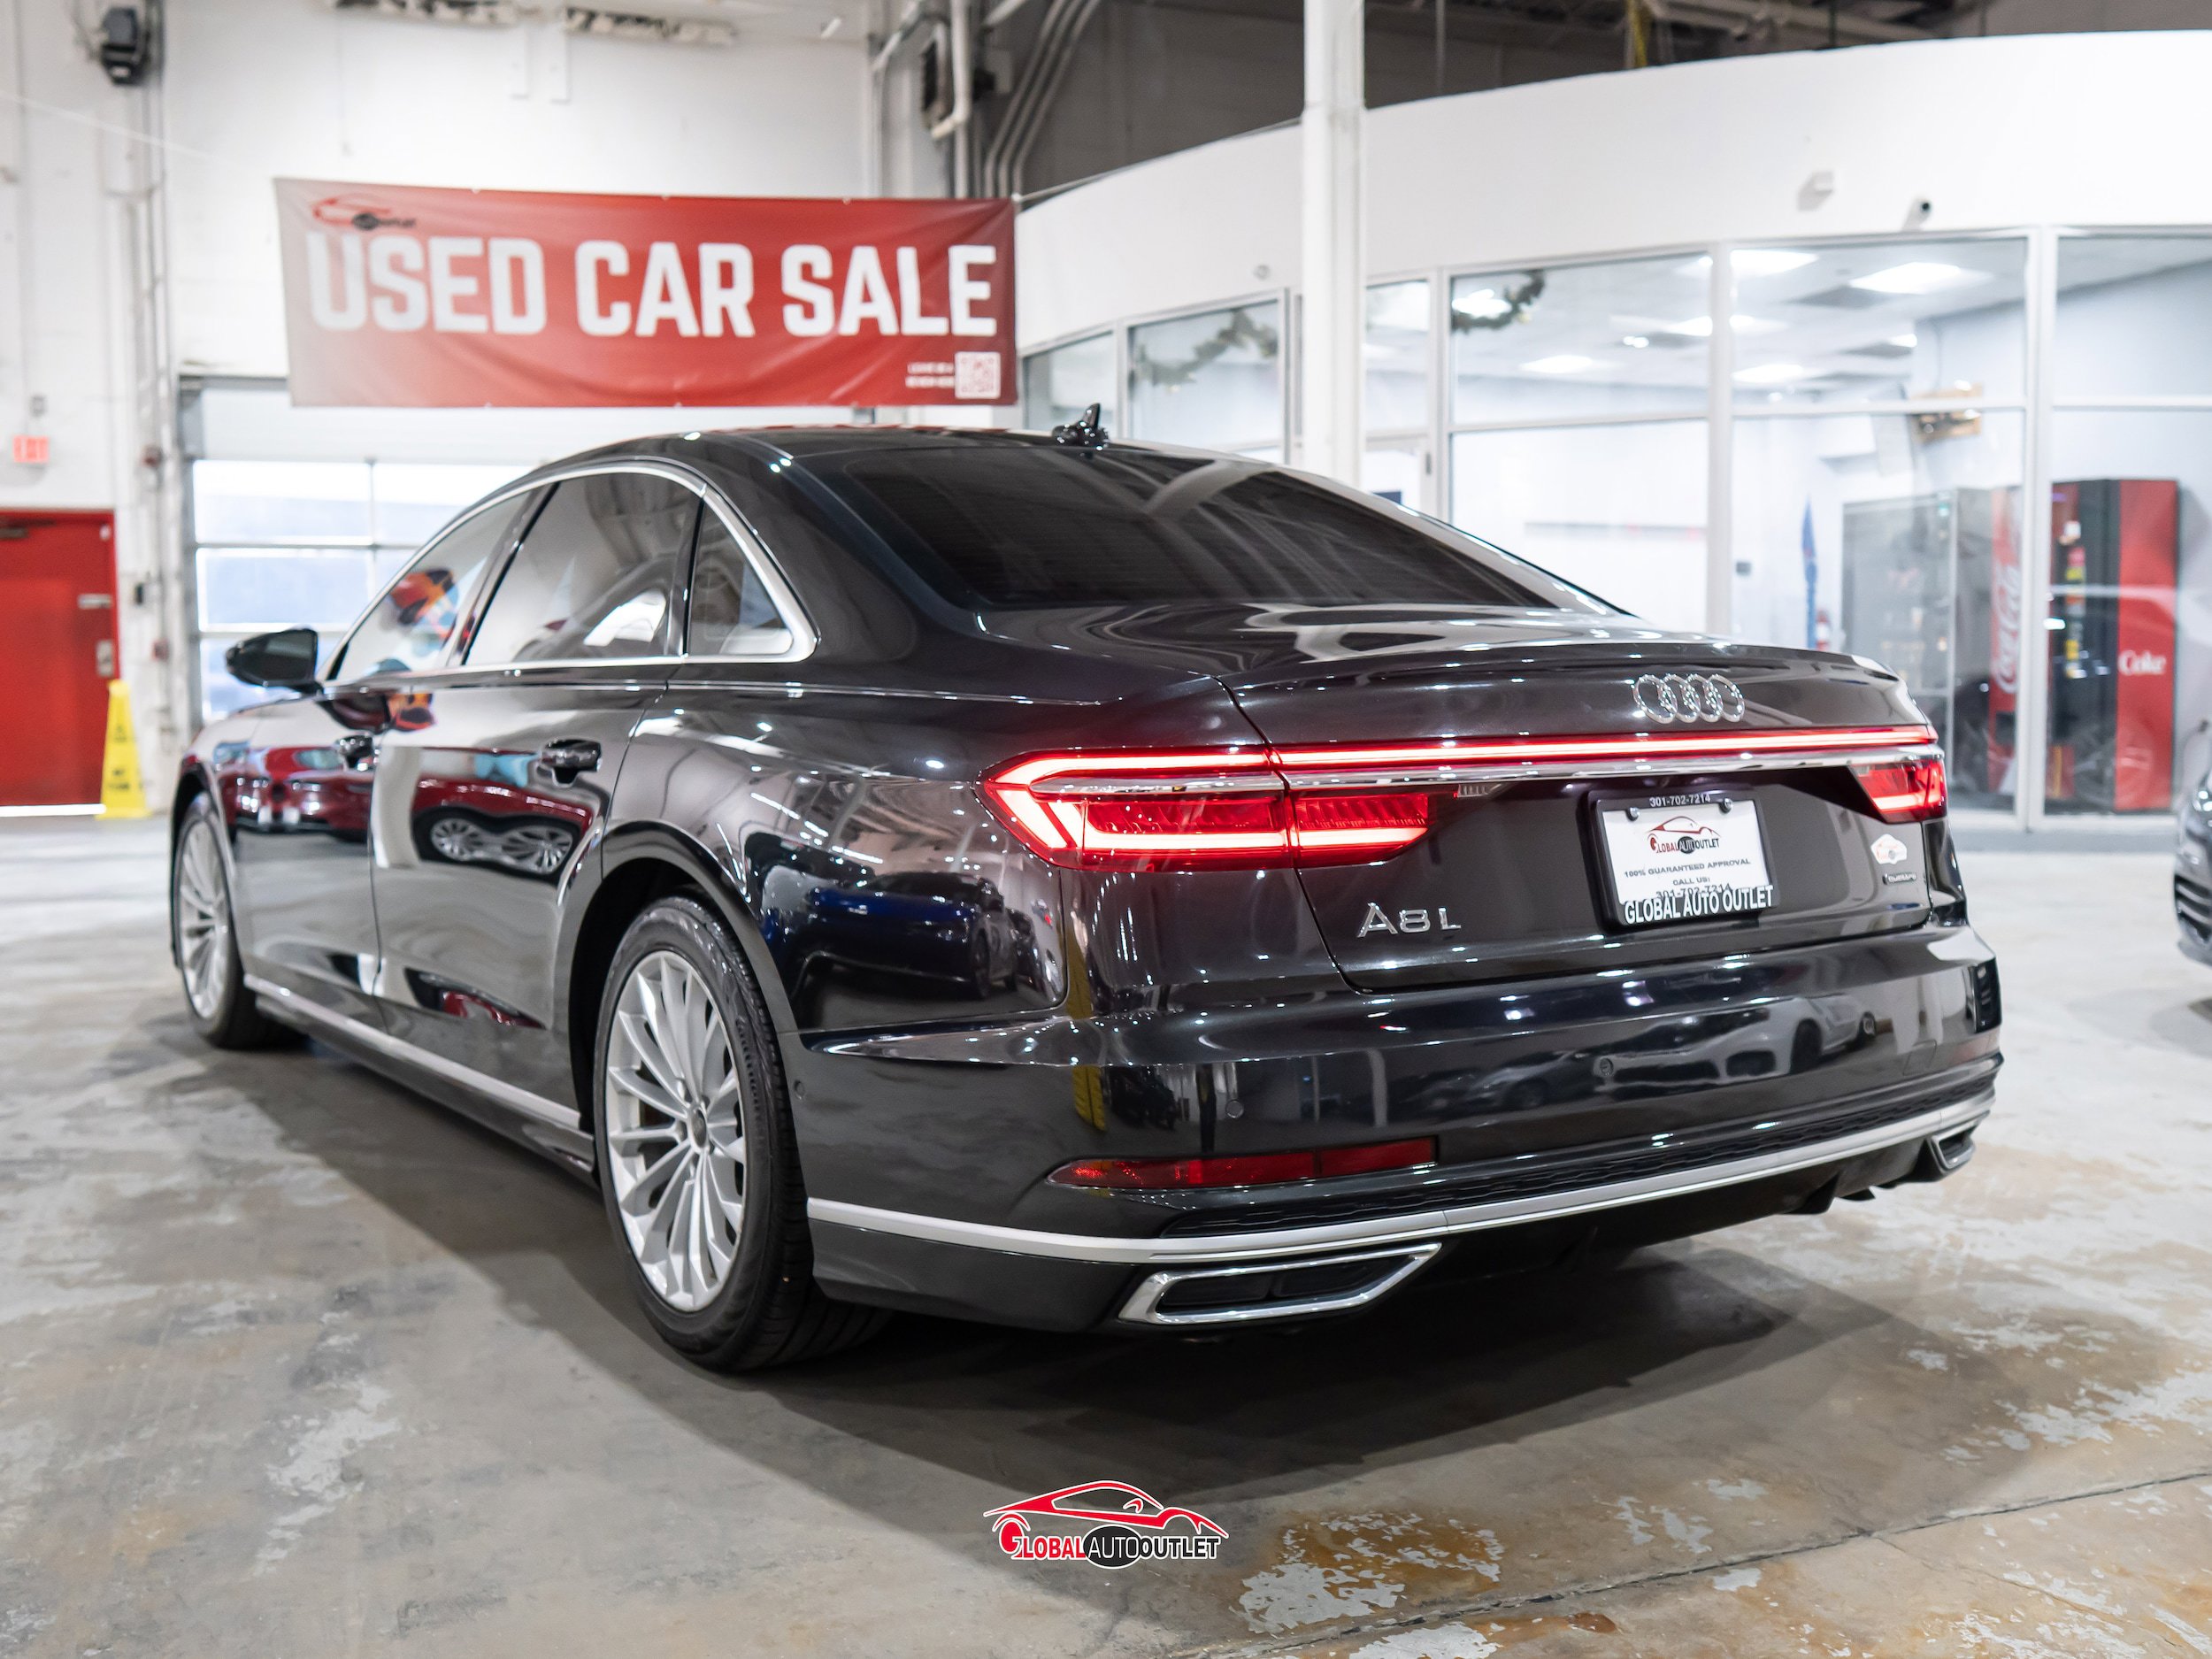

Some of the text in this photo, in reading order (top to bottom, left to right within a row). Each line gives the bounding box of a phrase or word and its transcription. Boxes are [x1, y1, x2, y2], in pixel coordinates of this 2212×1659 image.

[307, 234, 996, 337] USED CAR SALE
[2118, 649, 2166, 676] Coke
[1649, 794, 1711, 808] 301-702-7214
[1624, 858, 1751, 878] 100% GUARANTEED APPROVAL
[1624, 885, 1774, 925] GLOBAL AUTO OUTLET
